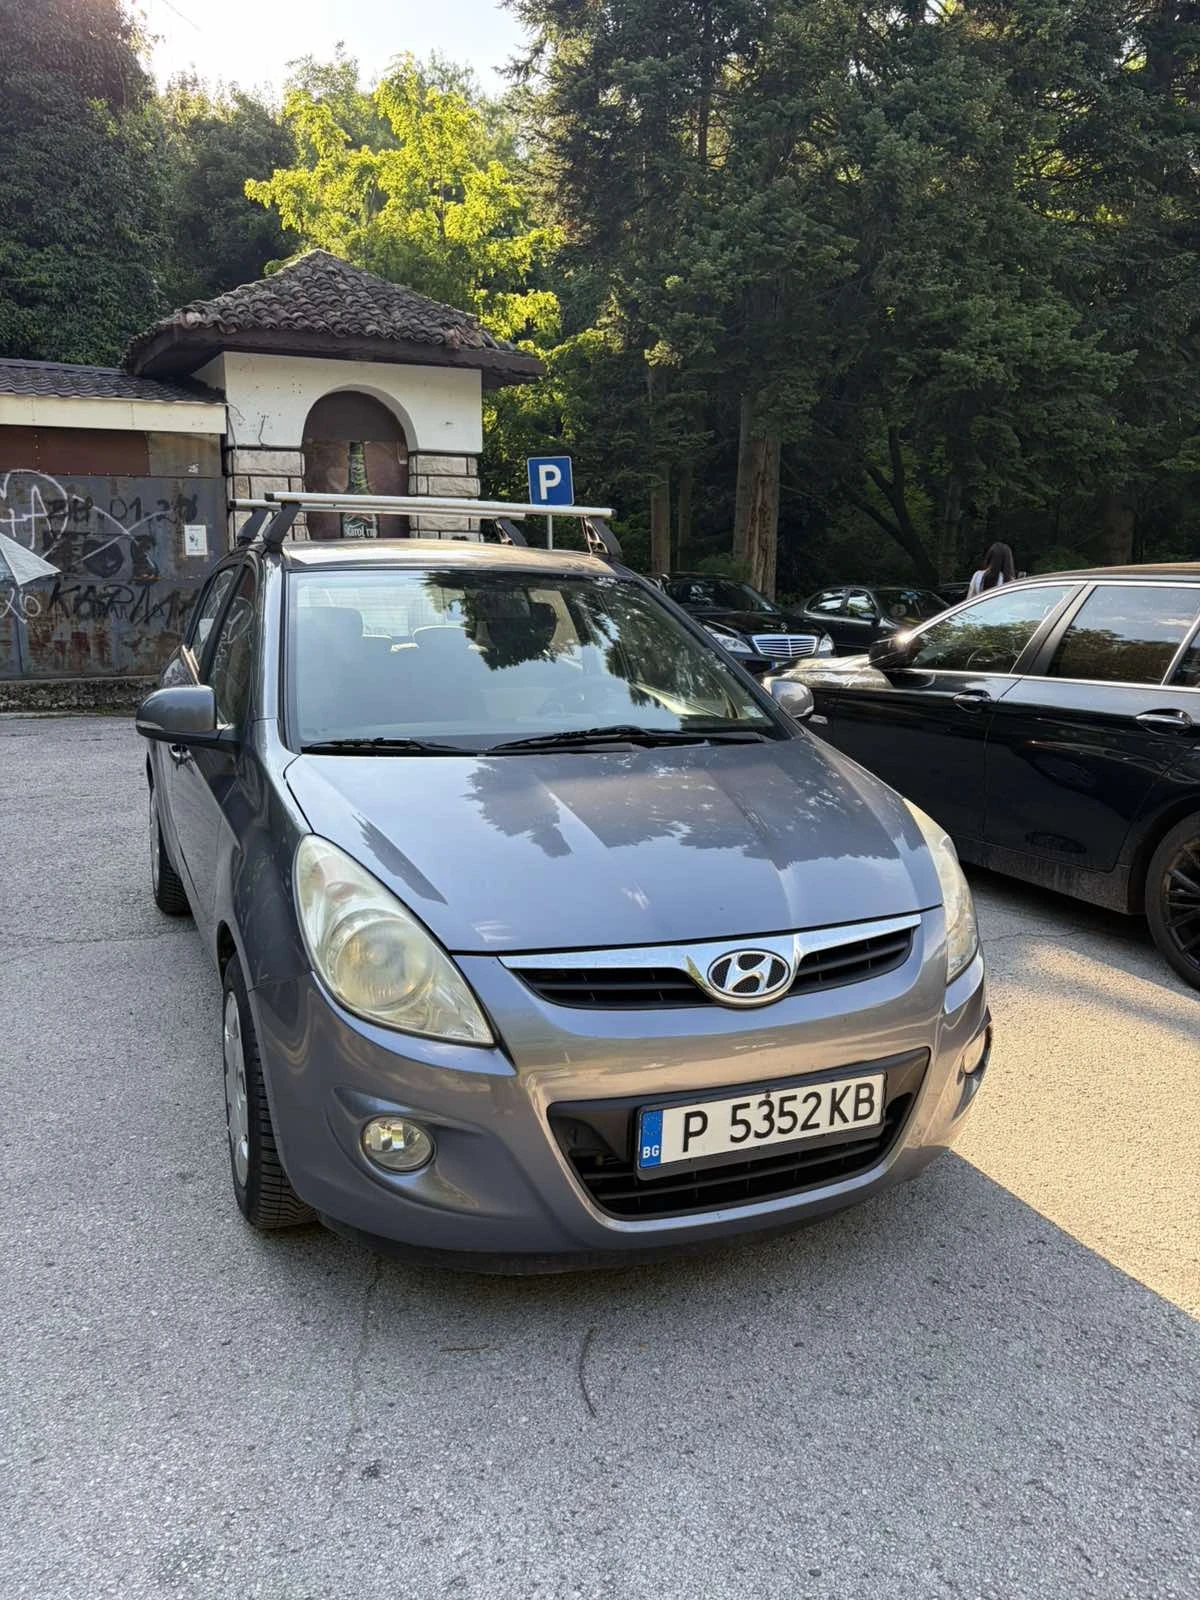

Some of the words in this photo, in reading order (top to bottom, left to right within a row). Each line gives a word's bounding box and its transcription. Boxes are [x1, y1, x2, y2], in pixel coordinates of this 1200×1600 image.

[538, 464, 561, 500] P
[682, 1110, 709, 1153] P
[729, 1091, 822, 1144] 5352
[828, 1082, 876, 1127] KB
[642, 1145, 660, 1158] BG
